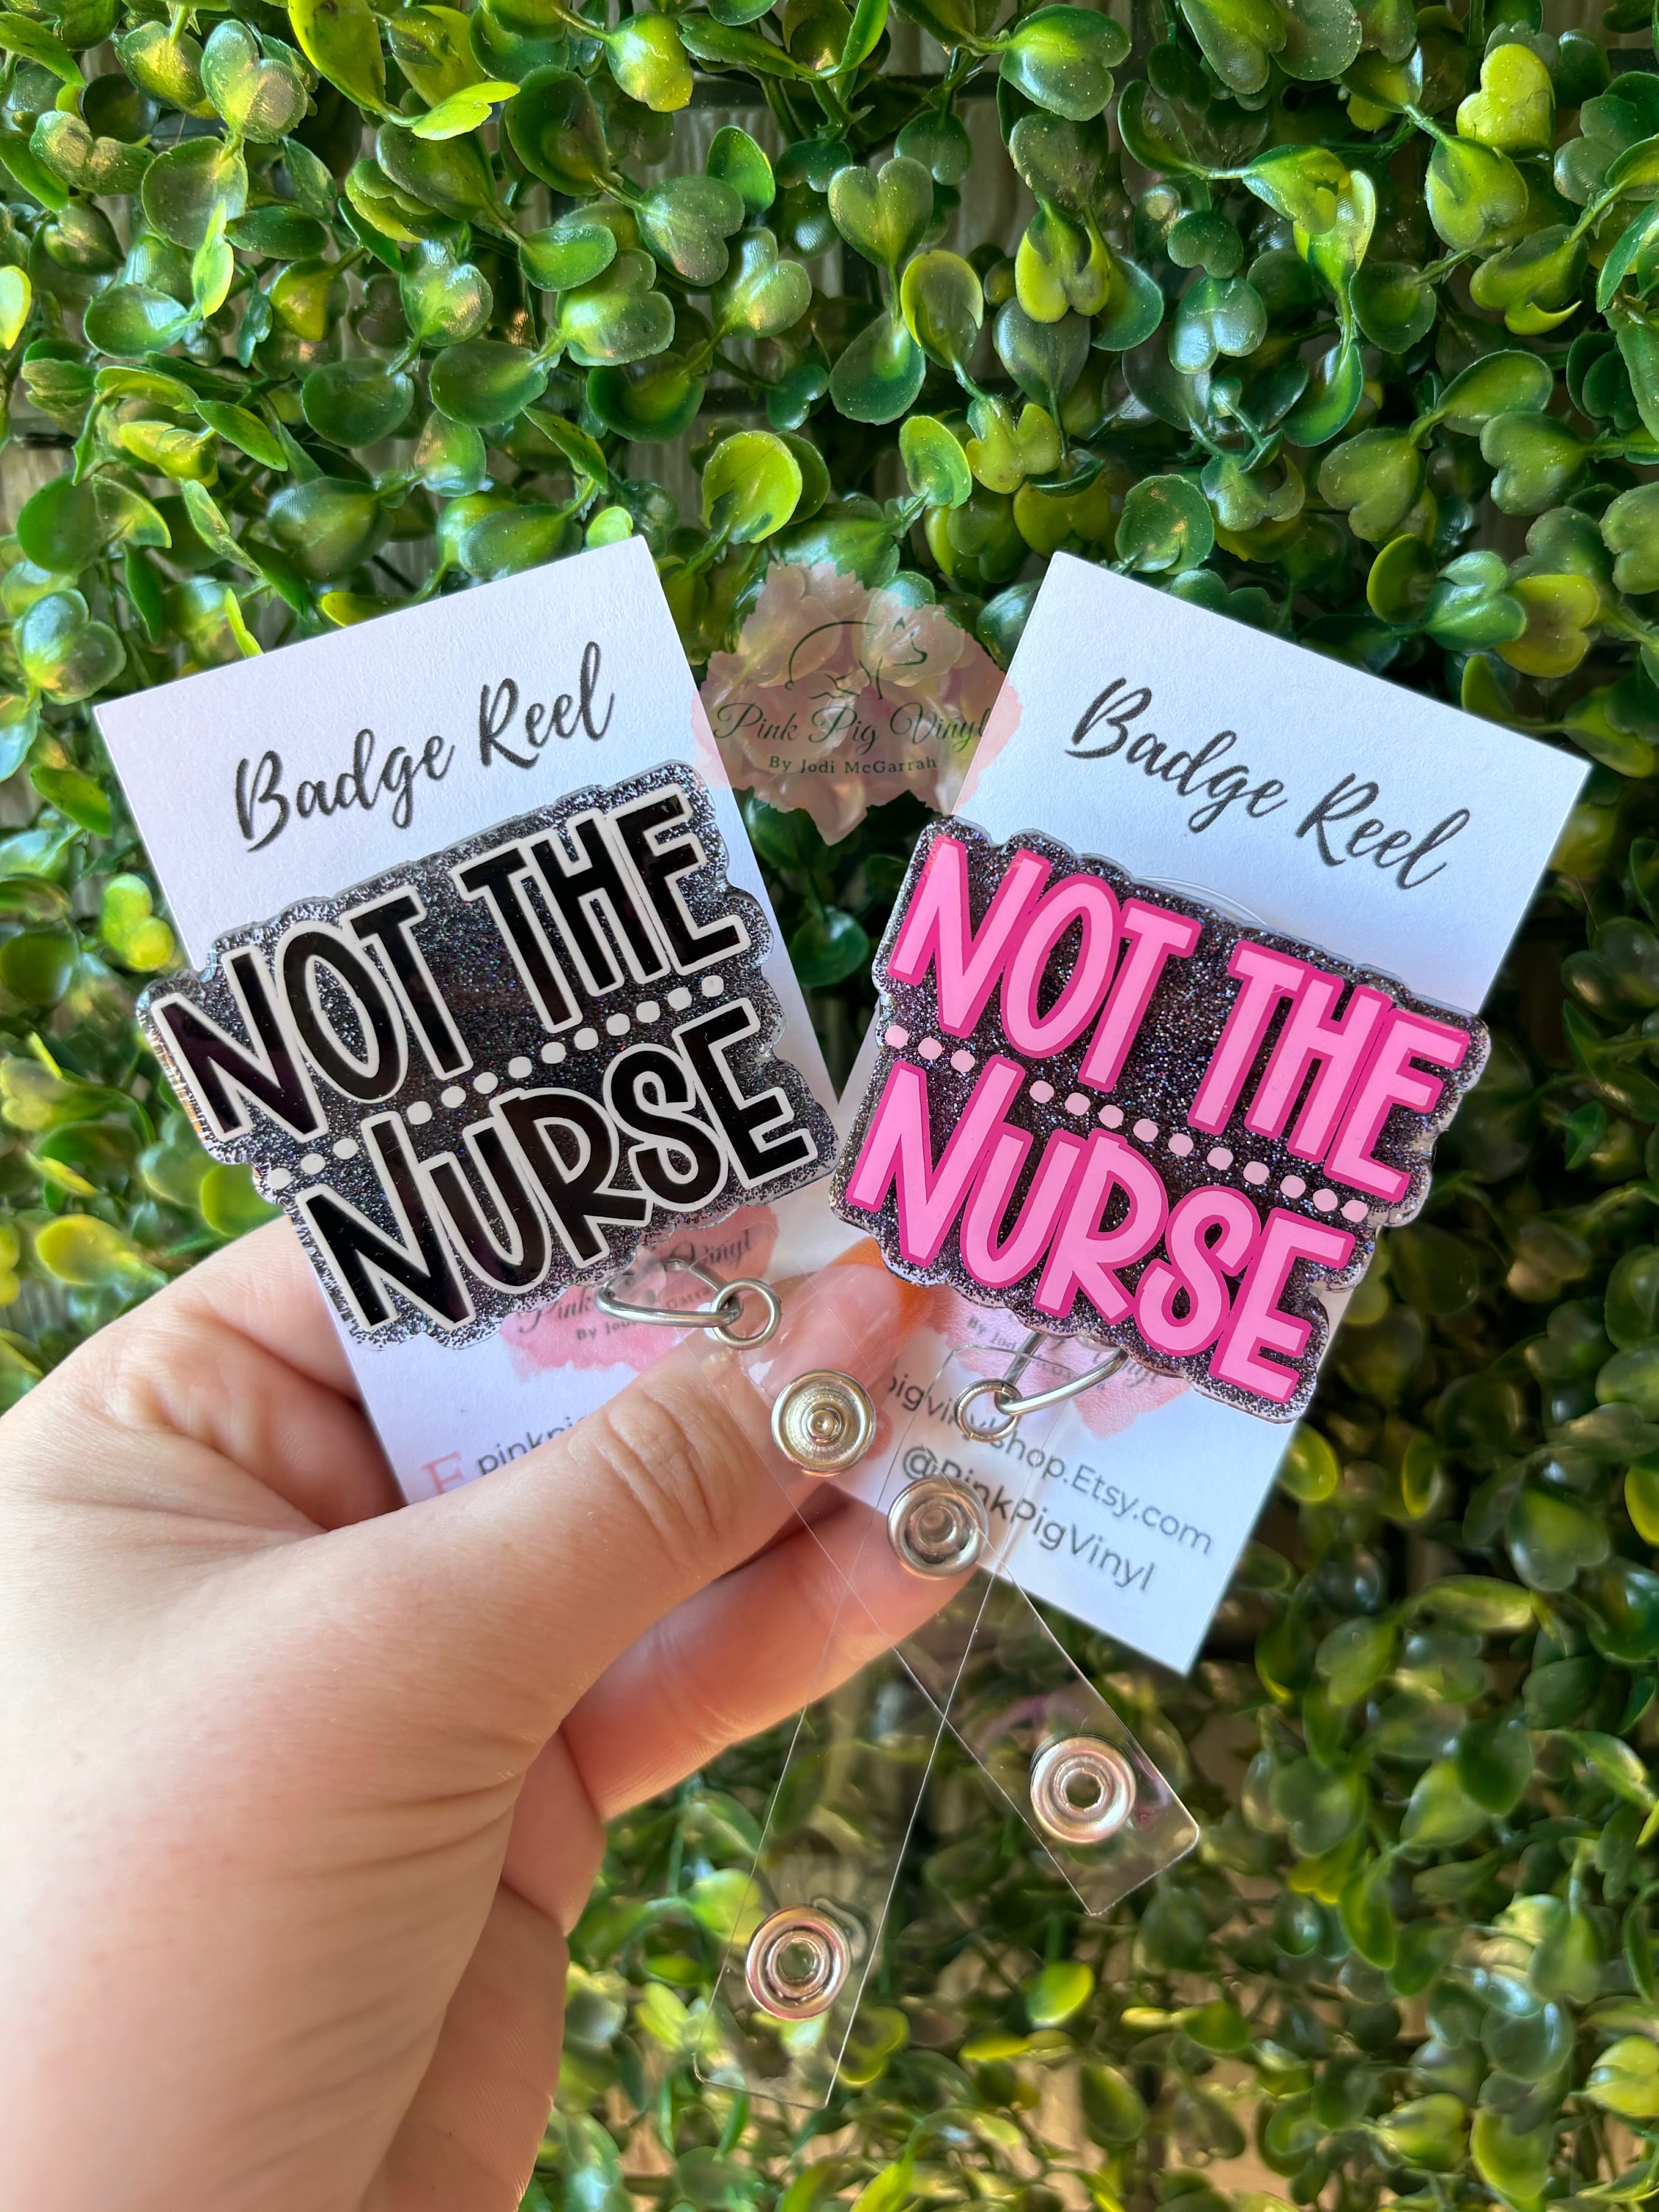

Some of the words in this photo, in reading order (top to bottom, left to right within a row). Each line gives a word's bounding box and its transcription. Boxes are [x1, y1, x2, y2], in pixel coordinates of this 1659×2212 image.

[233, 728, 455, 852] Badge
[478, 641, 614, 768] Reel
[1065, 677, 1286, 833] Badge
[1296, 772, 1471, 891] Reel
[151, 886, 473, 1141] NOT
[452, 785, 751, 1032] THE
[888, 834, 1202, 1092] NOT
[1187, 941, 1471, 1202] THE
[296, 998, 817, 1327] NURSE
[845, 1054, 1356, 1403] NURSE
